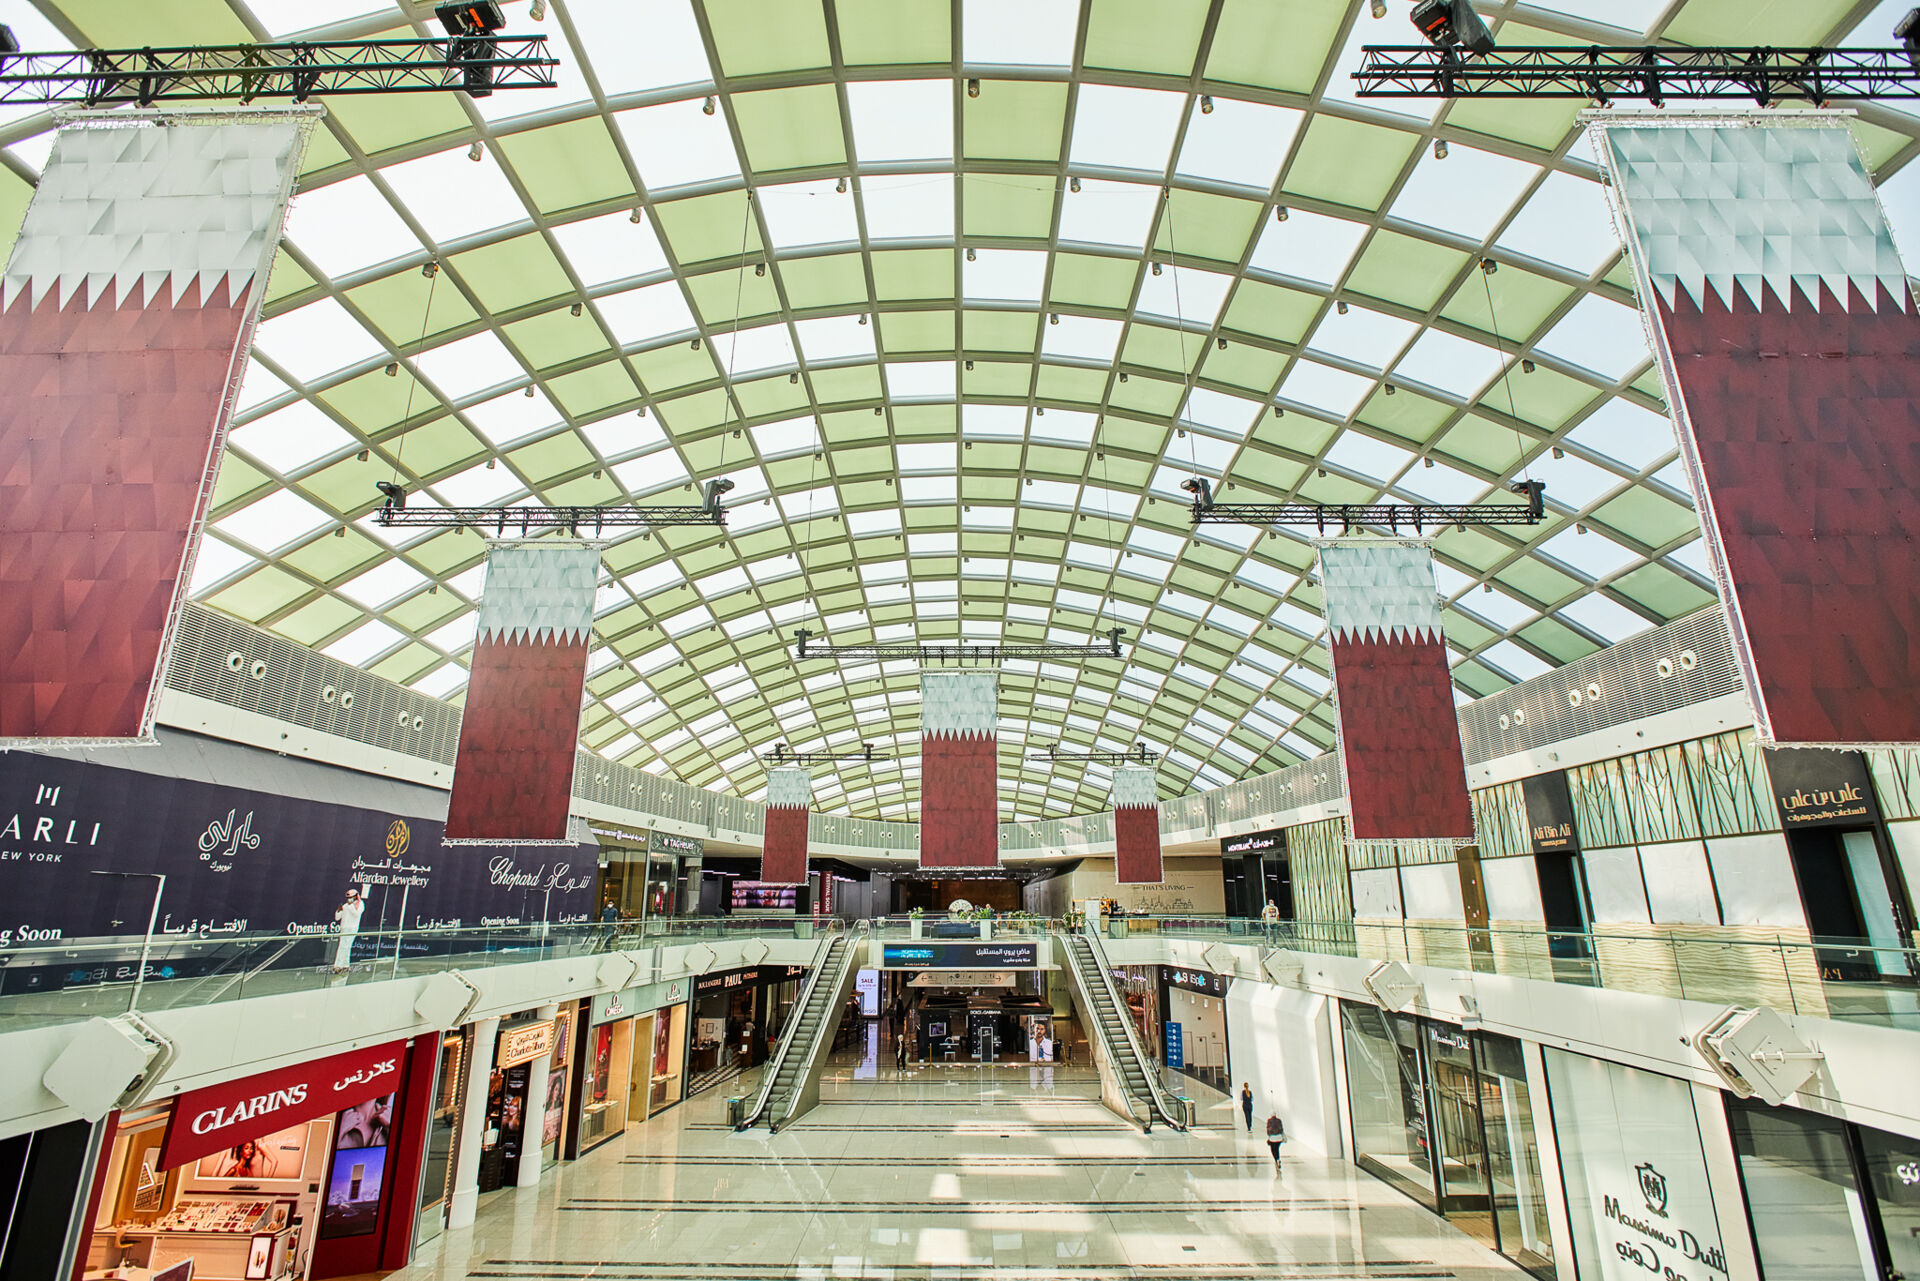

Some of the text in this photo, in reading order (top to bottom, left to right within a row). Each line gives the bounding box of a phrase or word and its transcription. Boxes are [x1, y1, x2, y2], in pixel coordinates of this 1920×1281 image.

[1781, 782, 1863, 813] علي بن علي
[0, 813, 101, 846] ARLI
[198, 808, 261, 861] مارلي
[1533, 822, 1572, 840] Ali Bin Ali
[1, 850, 63, 863] EW YORK
[349, 870, 430, 889] Alfardan Jewellery
[488, 855, 546, 892] Chopard
[200, 918, 248, 939] الافتتاح
[287, 920, 342, 936] Opening So
[480, 915, 521, 929] Opening Soon
[16, 923, 63, 942] Soon
[724, 973, 742, 988] PAUL
[605, 1004, 624, 1017] OMEGA
[191, 1083, 309, 1136] CLARINS
[1603, 1194, 1728, 1274] Massimo Dutt
